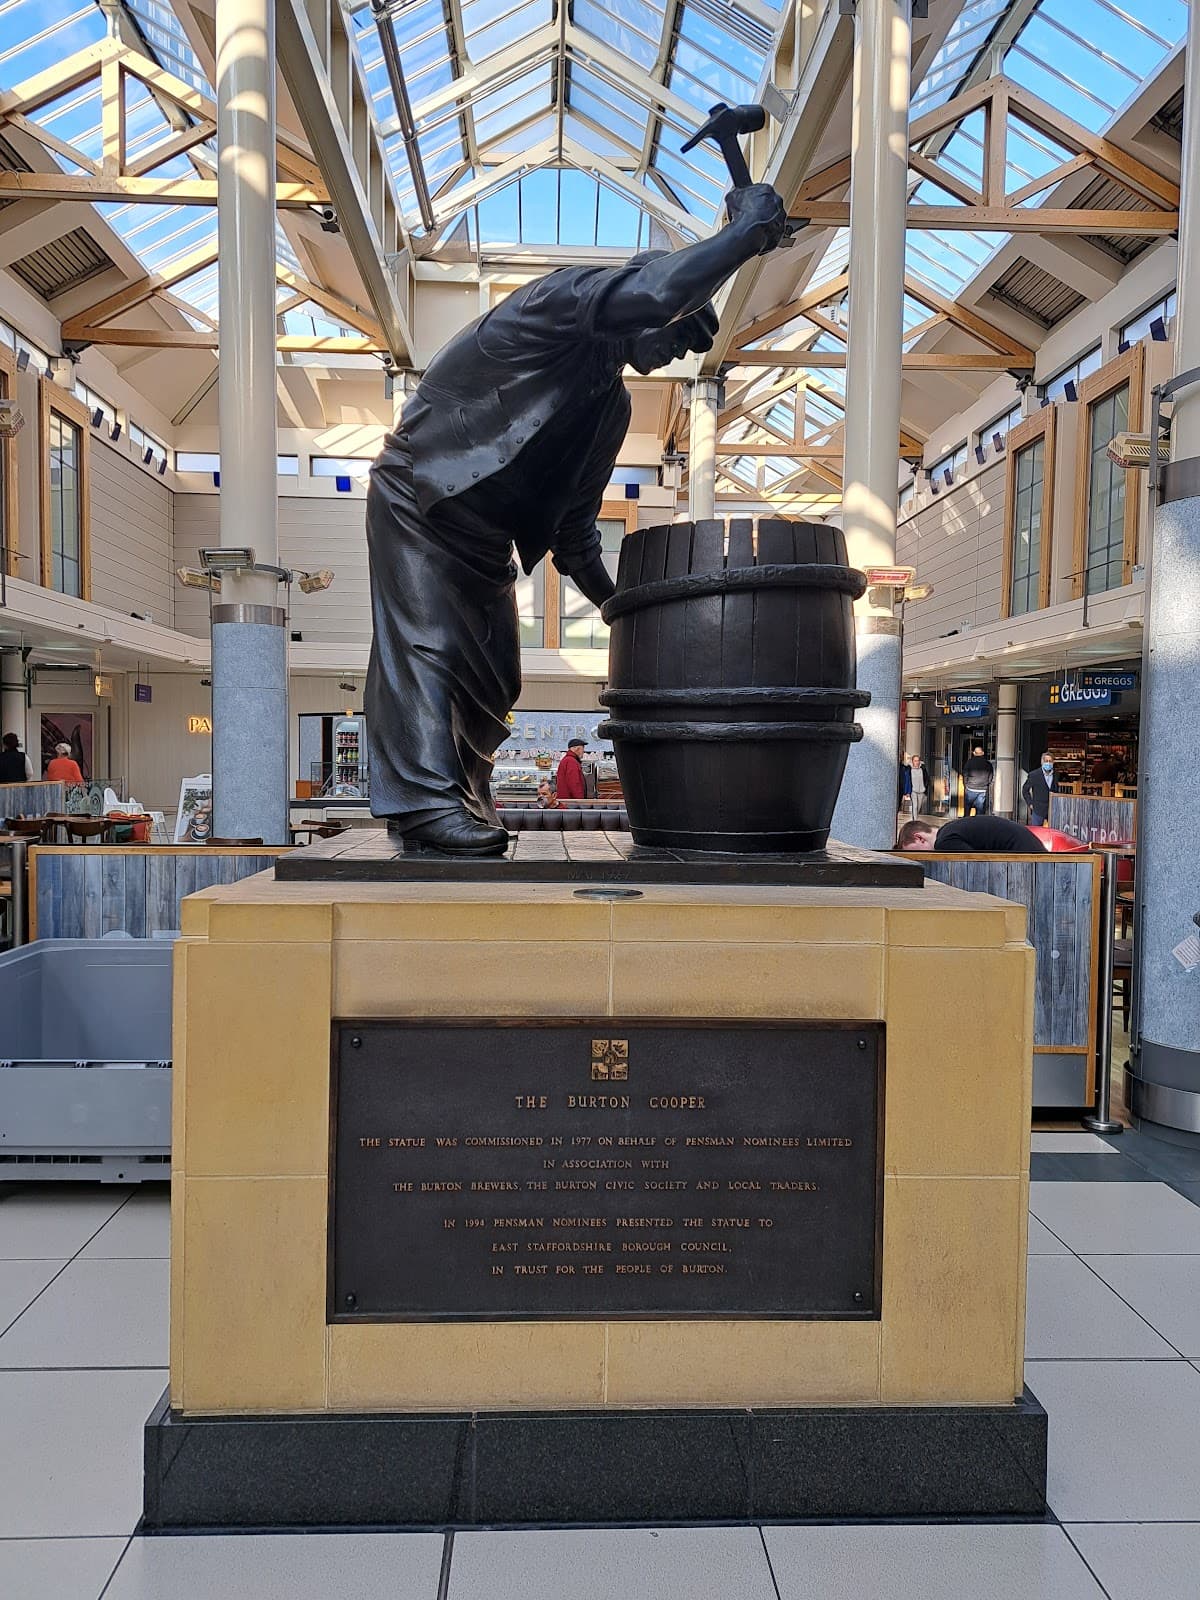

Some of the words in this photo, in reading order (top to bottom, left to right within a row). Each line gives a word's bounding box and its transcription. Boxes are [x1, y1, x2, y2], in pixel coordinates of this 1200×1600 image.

[1094, 677, 1132, 686] GREGGS
[514, 1095, 548, 1109] THE
[566, 1095, 631, 1109] BURTON
[649, 1095, 707, 1109] COOPER
[359, 1136, 381, 1147] THE
[388, 1136, 426, 1147] STATUE
[435, 1136, 458, 1147] WAS
[464, 1136, 544, 1147] COMMISSIONED
[550, 1136, 563, 1147] IN
[570, 1136, 592, 1147] 1977
[597, 1136, 614, 1147] ON
[617, 1136, 657, 1147] BEHALF
[664, 1136, 677, 1147] OF
[685, 1136, 735, 1147] PENSMAN
[743, 1136, 800, 1147] NOMINEES
[806, 1136, 853, 1147] LIMITED
[543, 1159, 556, 1169] IN
[561, 1159, 633, 1169] ASSOCIATION
[641, 1159, 670, 1169] WITH
[392, 1181, 414, 1192] THE
[420, 1181, 463, 1192] BURTON
[526, 1181, 548, 1192] THE
[555, 1181, 597, 1192] BURTON
[605, 1181, 635, 1192] CIVIC
[644, 1181, 688, 1192] SOCIETY
[695, 1181, 720, 1192] AND
[727, 1181, 762, 1192] LOCAL
[769, 1181, 821, 1192] TRADERS.
[444, 1217, 456, 1228] IN
[464, 1217, 486, 1228] 1994
[493, 1217, 545, 1228] PENSMAN
[552, 1217, 608, 1228] NOMINEES
[615, 1217, 674, 1228] PRESENTED
[682, 1217, 704, 1228] THE
[711, 1217, 751, 1228] STATUE
[757, 1217, 774, 1228] TO
[491, 1242, 519, 1252] EAST
[526, 1242, 613, 1252] STAFFORDSHIRE
[621, 1242, 672, 1252] BOROUGH
[491, 1264, 504, 1275] IN
[513, 1264, 549, 1275] TRUST
[555, 1264, 577, 1275] FOR
[582, 1264, 604, 1275] THE
[615, 1264, 652, 1275] PEOPLE
[659, 1264, 674, 1275] OF
[681, 1264, 729, 1275] BURTON.
